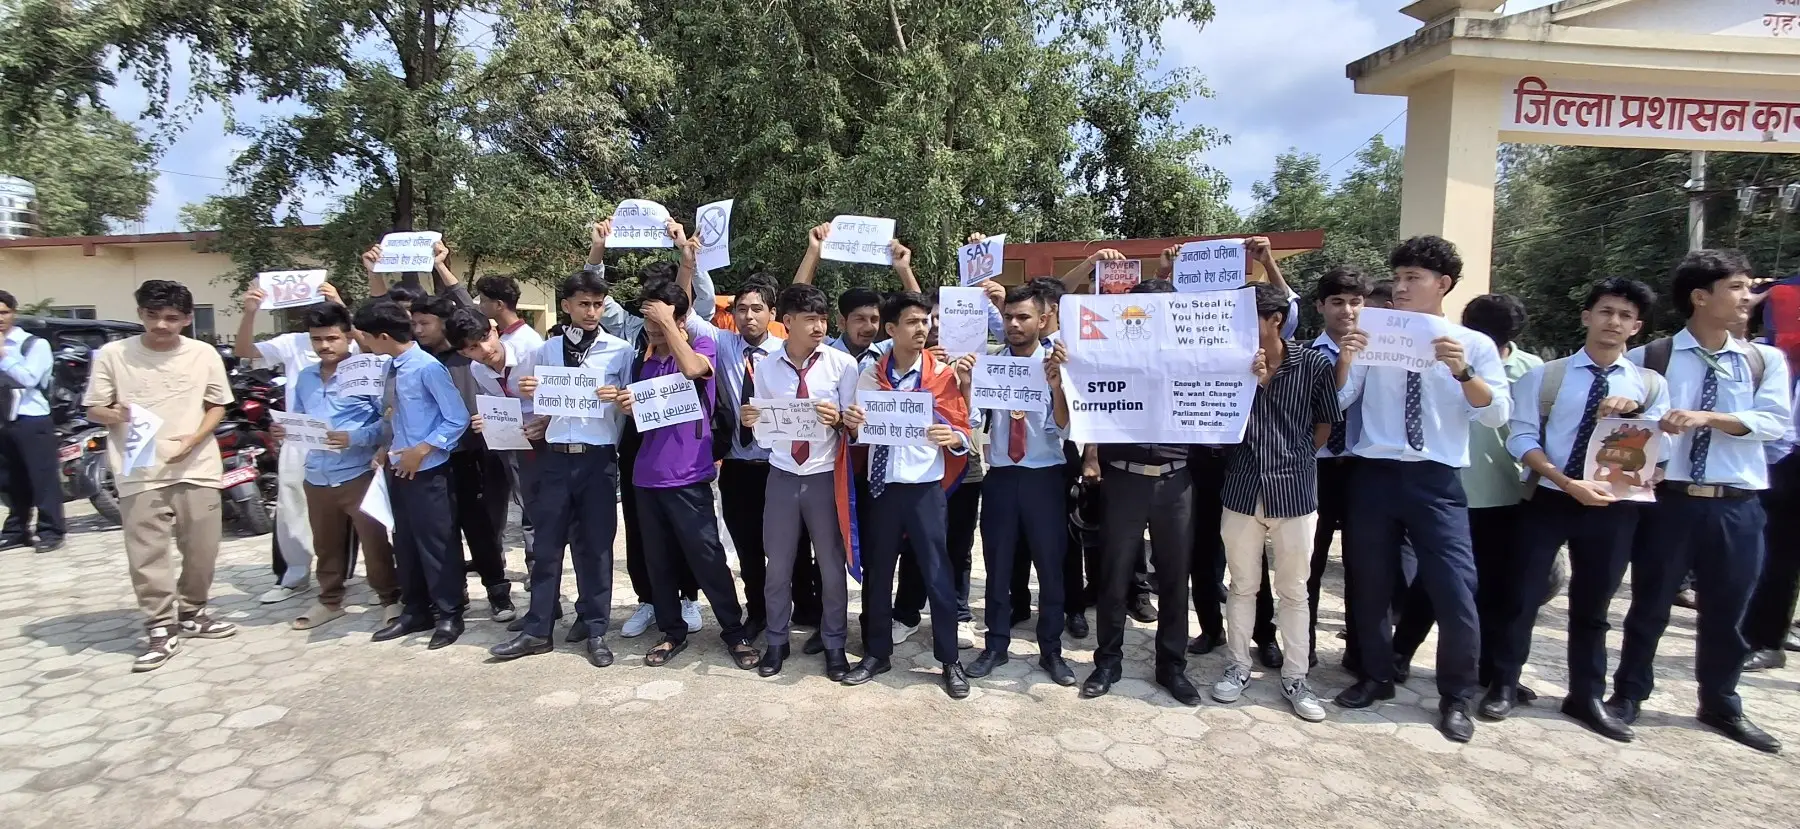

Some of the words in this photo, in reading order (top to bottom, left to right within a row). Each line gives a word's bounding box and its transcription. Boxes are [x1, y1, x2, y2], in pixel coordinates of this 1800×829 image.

[1763, 13, 1797, 36] गृह
[1513, 76, 1616, 127] जिल्ला
[1619, 96, 1750, 132] प्रशासन
[1752, 101, 1800, 134] का
[967, 240, 991, 260] SAY
[1180, 247, 1211, 262] जनताको
[1104, 261, 1134, 270] POWER
[272, 274, 309, 285] SAY
[1178, 270, 1201, 284] नेताको
[1204, 270, 1216, 283] ऐश
[1169, 301, 1188, 309] You
[1192, 300, 1220, 308] Steal
[1225, 299, 1236, 308] it,
[944, 307, 984, 316] Corruption
[1172, 313, 1191, 321] You
[1195, 312, 1217, 320] hide
[1219, 324, 1230, 332] it,
[1386, 315, 1411, 329] SAY
[1199, 336, 1228, 346] fight.
[1378, 335, 1396, 344] NO
[1400, 336, 1414, 348] TO
[1358, 351, 1434, 369] CORRUPTION
[987, 363, 1006, 376] दमन
[541, 373, 571, 386] जनताको
[660, 381, 692, 400] जनताकै
[974, 384, 1011, 401] जवाफदेही
[1088, 381, 1126, 393] STOP
[538, 393, 561, 408] नेताको
[564, 395, 576, 409] ऐश
[865, 398, 897, 412] जनताको
[1073, 399, 1144, 413] Corruption
[483, 413, 518, 422] Corruption
[663, 402, 700, 421] जनताको
[863, 420, 887, 436] नेताको
[890, 422, 902, 437] ऐश
